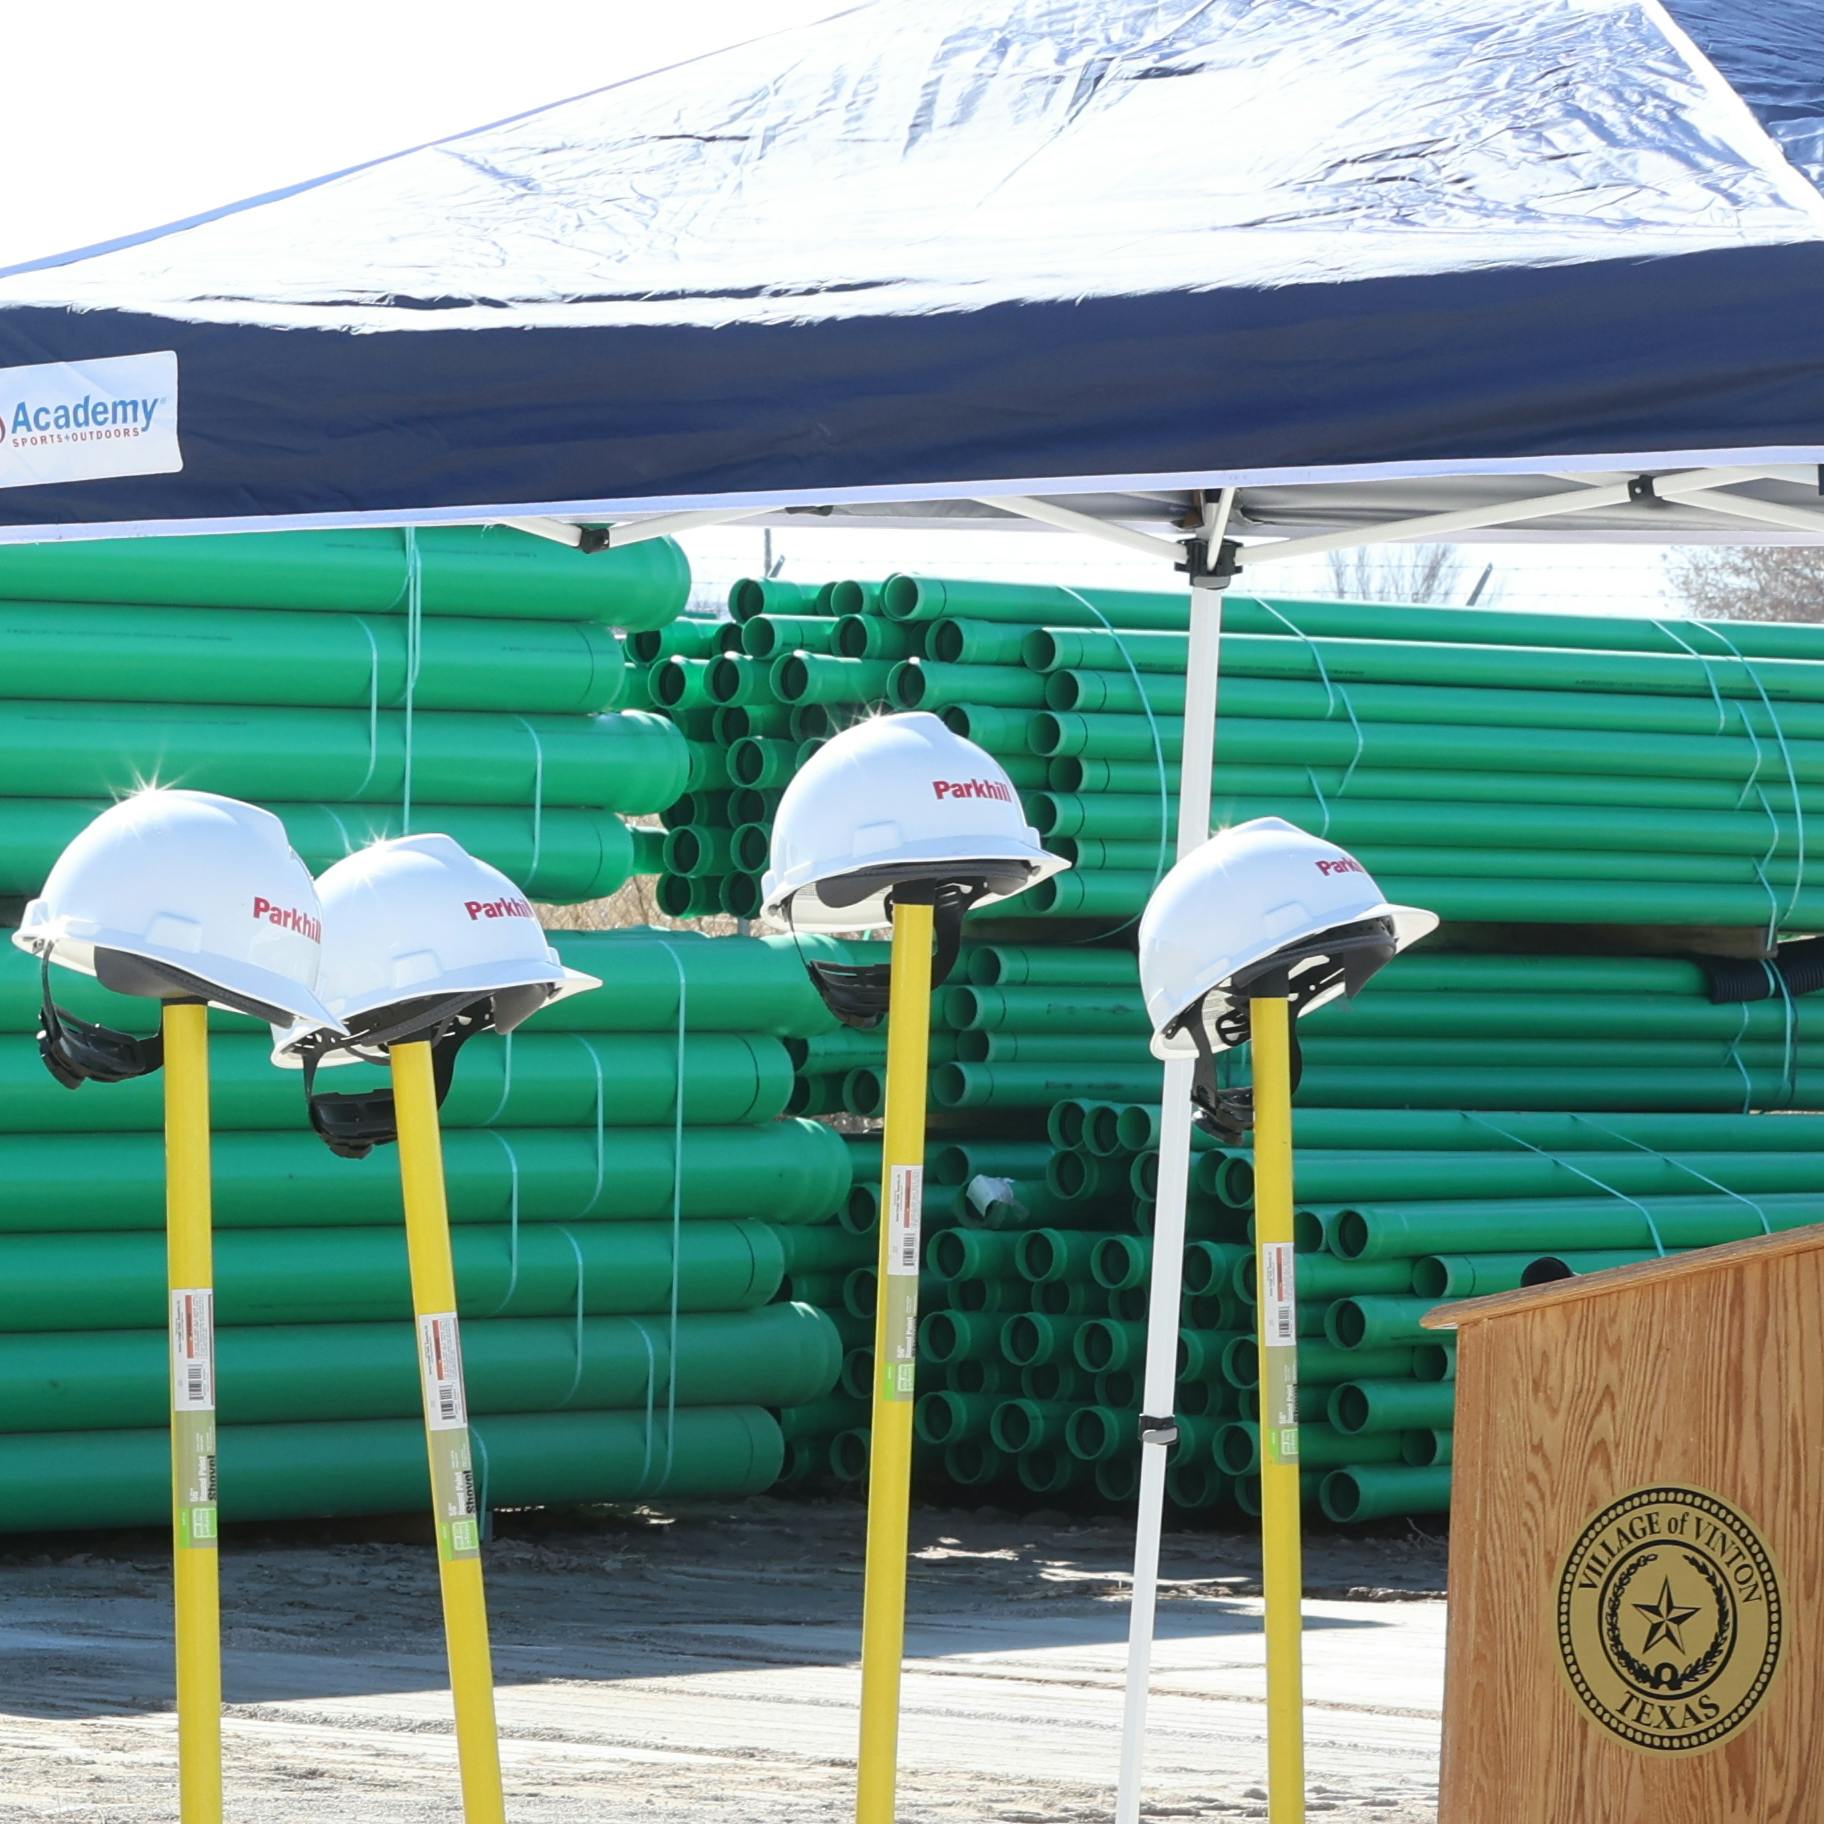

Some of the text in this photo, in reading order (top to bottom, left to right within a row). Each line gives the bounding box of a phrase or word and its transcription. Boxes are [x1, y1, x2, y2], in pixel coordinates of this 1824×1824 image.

[11, 395, 158, 433] Academy
[253, 896, 321, 944] Parkhill
[1579, 1512, 1762, 1604] VILLAGE of VINTON
[1615, 1691, 1721, 1730] TEXAS
